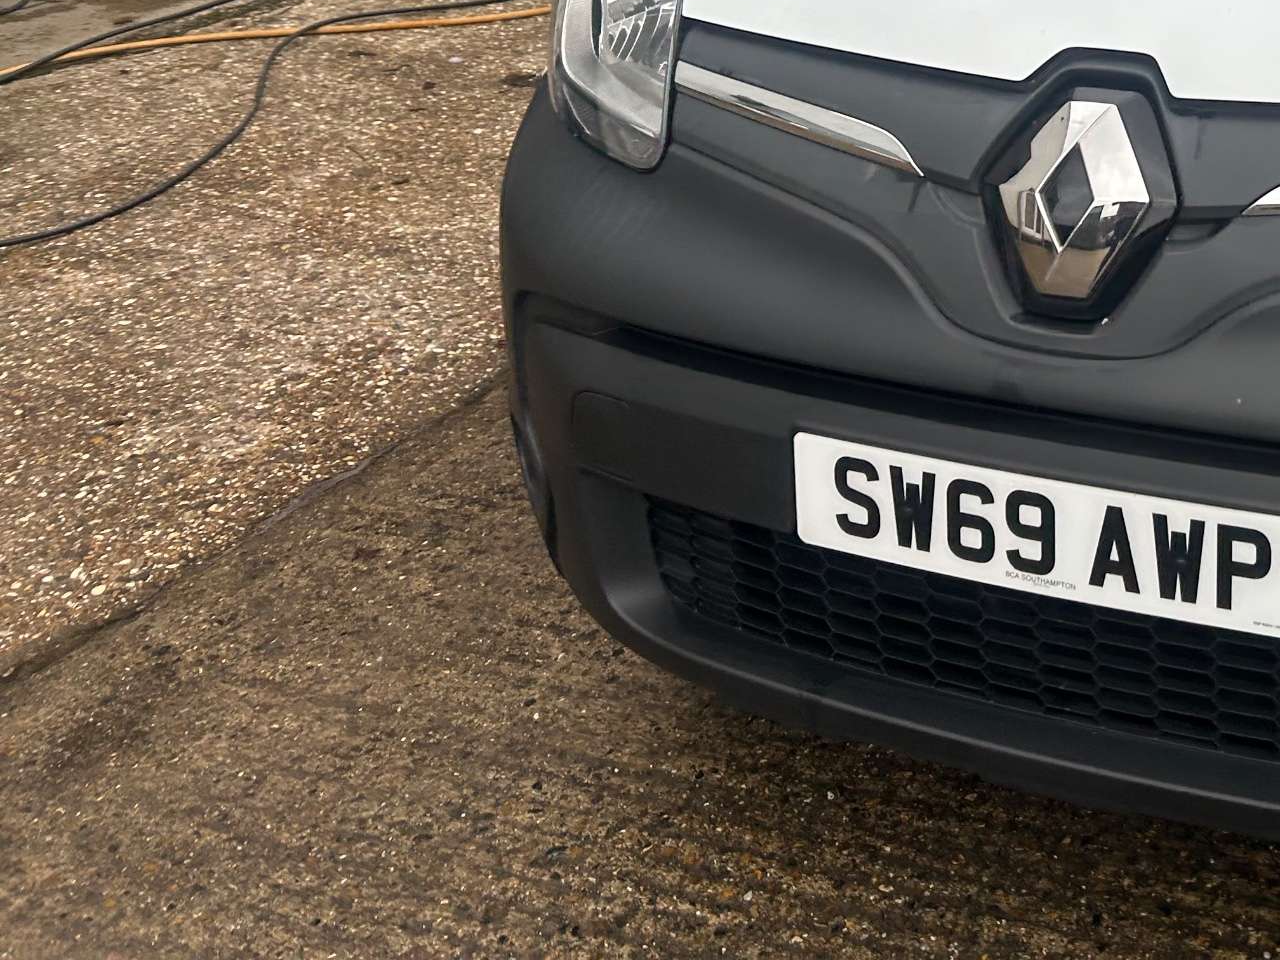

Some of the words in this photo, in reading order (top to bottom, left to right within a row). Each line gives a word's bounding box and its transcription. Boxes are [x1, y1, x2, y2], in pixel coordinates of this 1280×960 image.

[834, 456, 1056, 576] SW69
[1088, 505, 1271, 611] AWP
[1021, 573, 1077, 591] SOUTHAMPTON
